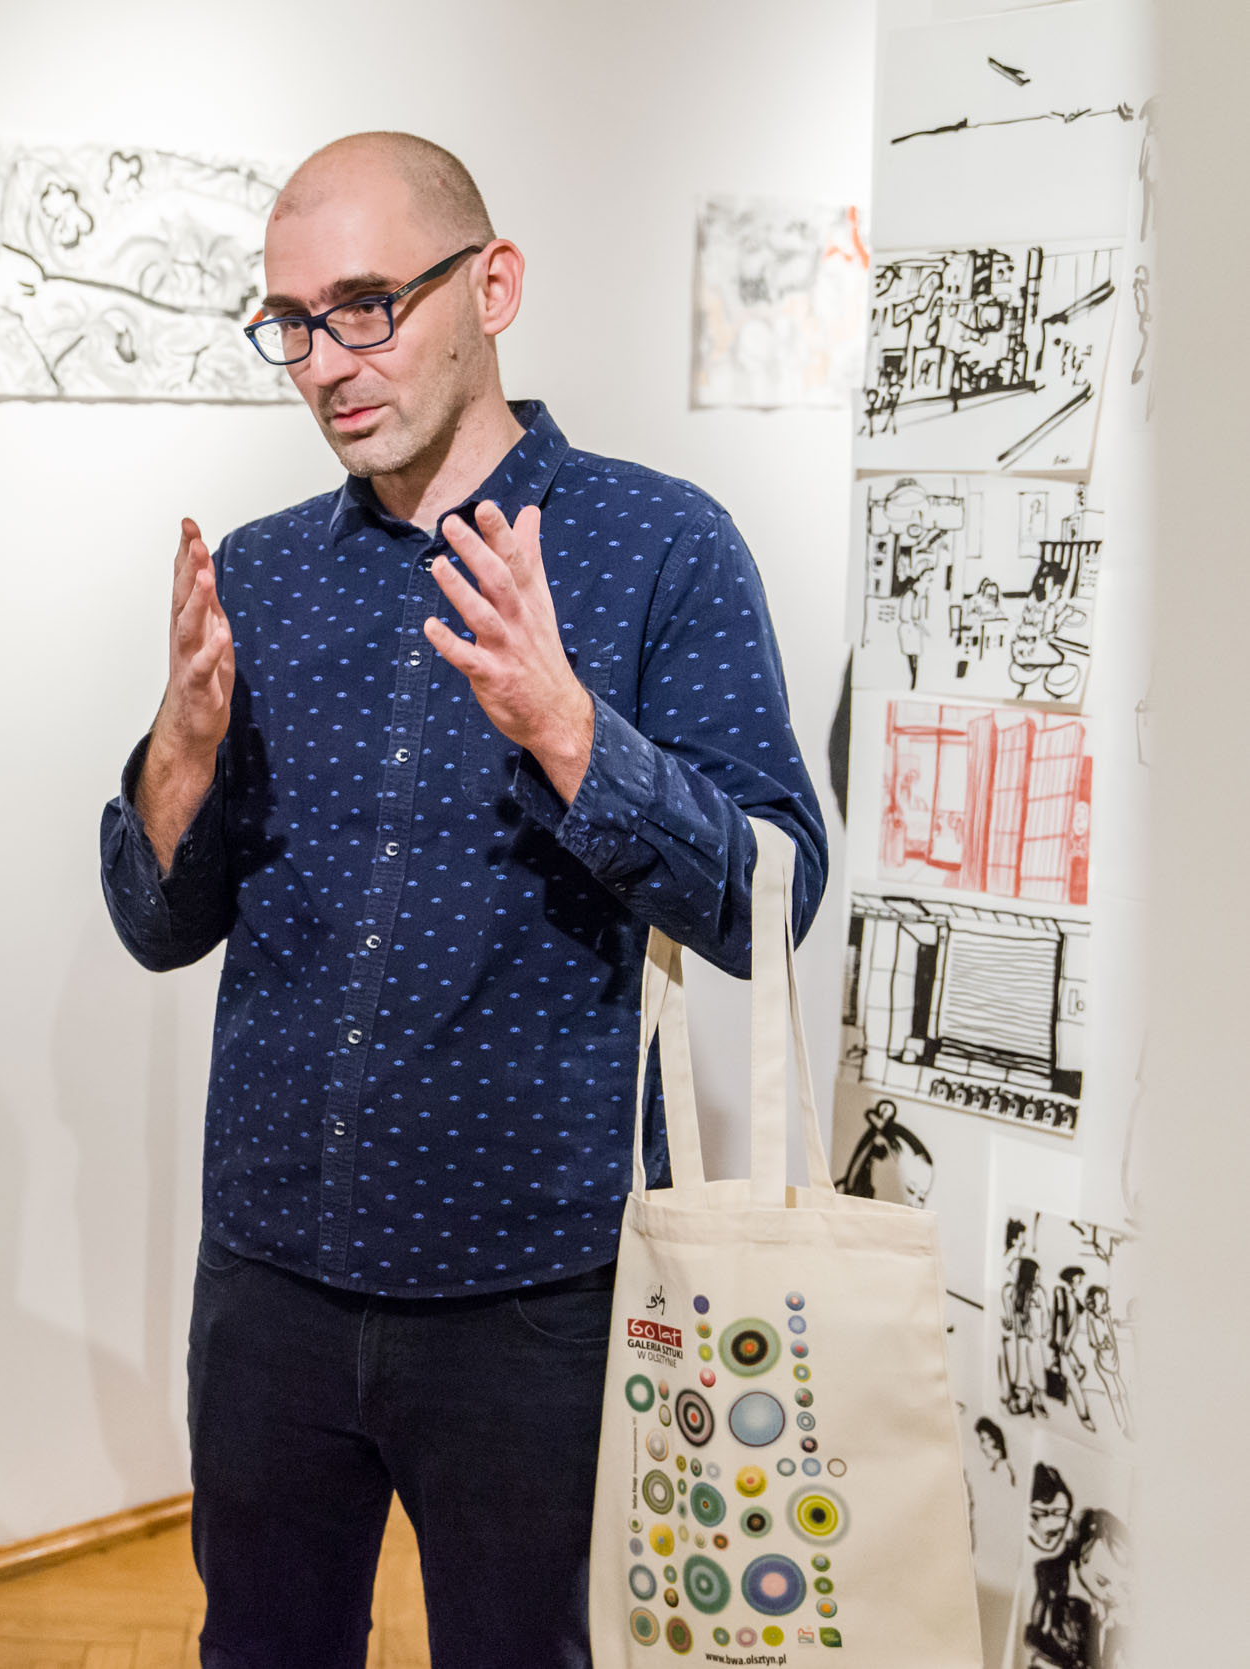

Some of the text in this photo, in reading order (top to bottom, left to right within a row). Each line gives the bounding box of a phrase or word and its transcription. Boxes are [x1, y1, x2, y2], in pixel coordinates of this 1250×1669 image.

[631, 1320, 680, 1346] 60 lat
[627, 1338, 683, 1360] GALERIA SZTUKI
[637, 1350, 677, 1369] W OLSZTYNIE
[705, 1652, 787, 1667] www.bwa.olsztyn.pl
